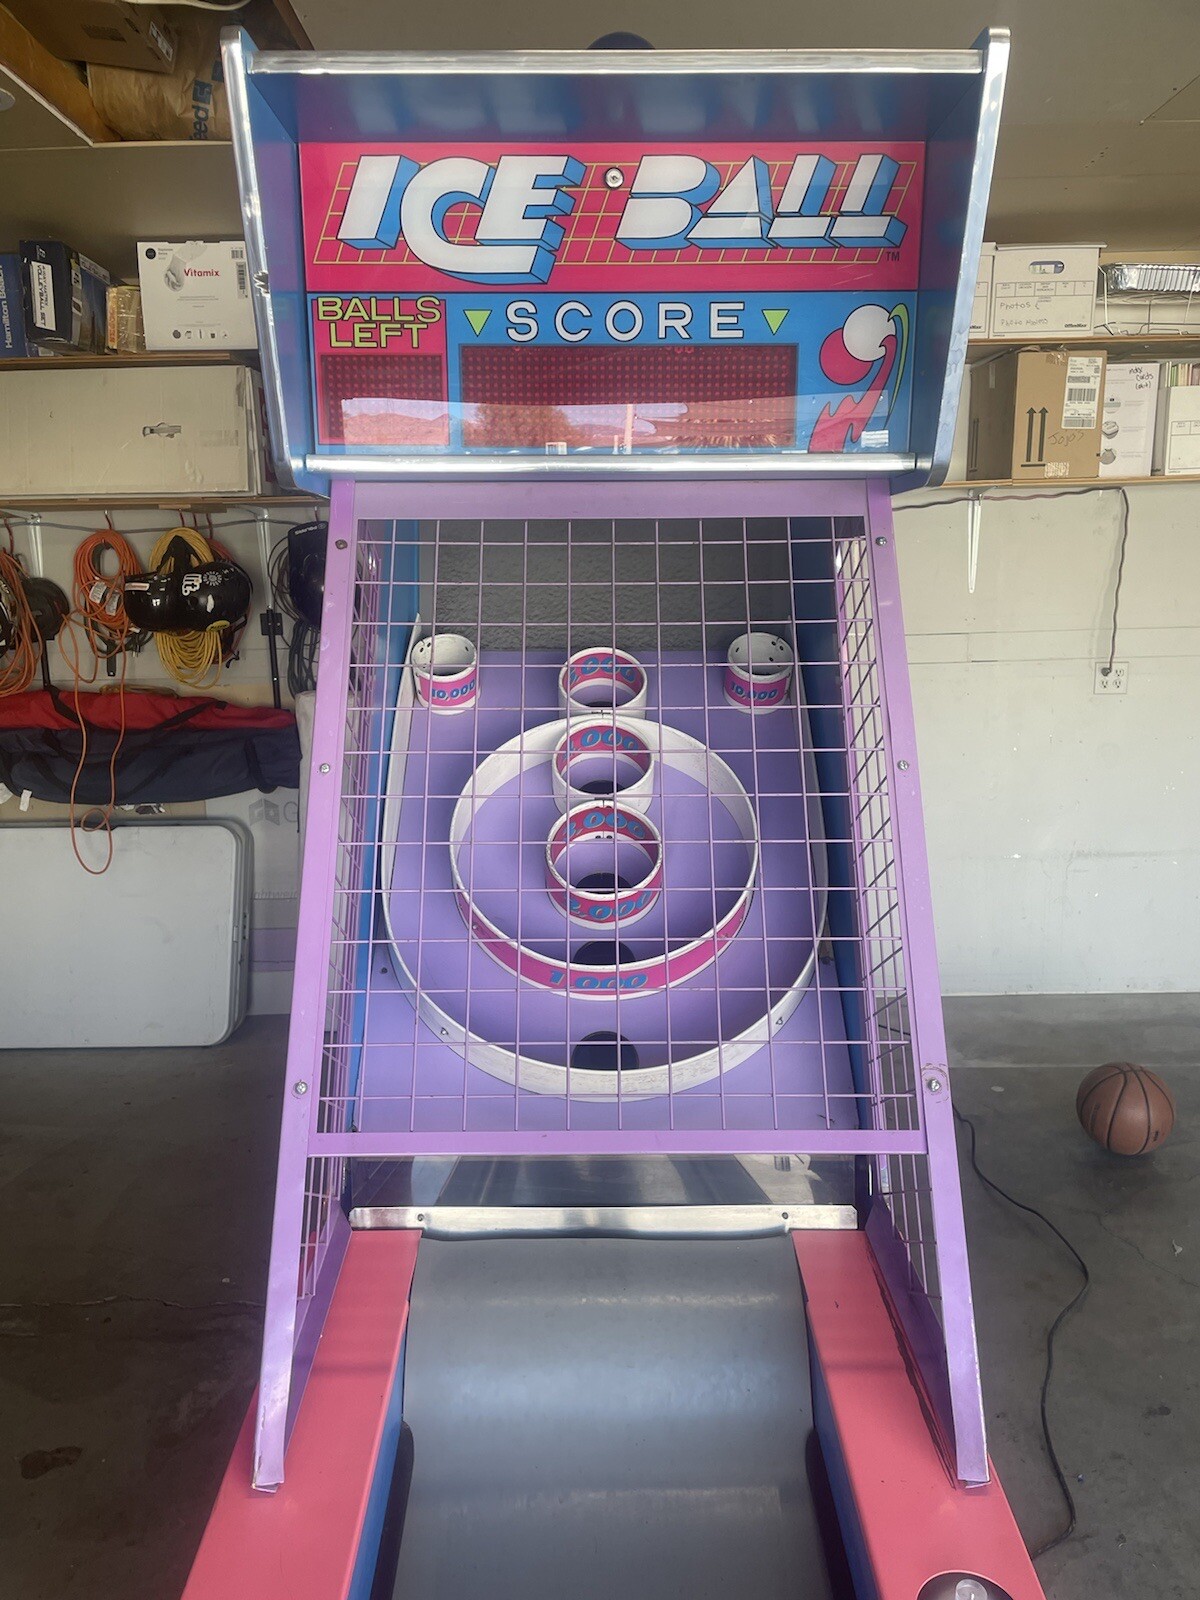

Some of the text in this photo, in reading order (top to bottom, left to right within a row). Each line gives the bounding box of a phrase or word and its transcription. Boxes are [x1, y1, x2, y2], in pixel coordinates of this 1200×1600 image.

[336, 153, 908, 286] ICE BALL
[886, 251, 900, 261] TM
[184, 268, 220, 277] Vitamix
[37, 265, 45, 310] VOLLEYBALL
[316, 295, 442, 323] BALLS
[505, 300, 745, 342] SCORE
[2, 301, 12, 348] Hamilton
[328, 321, 429, 348] LEFT
[731, 681, 778, 701] 10,000
